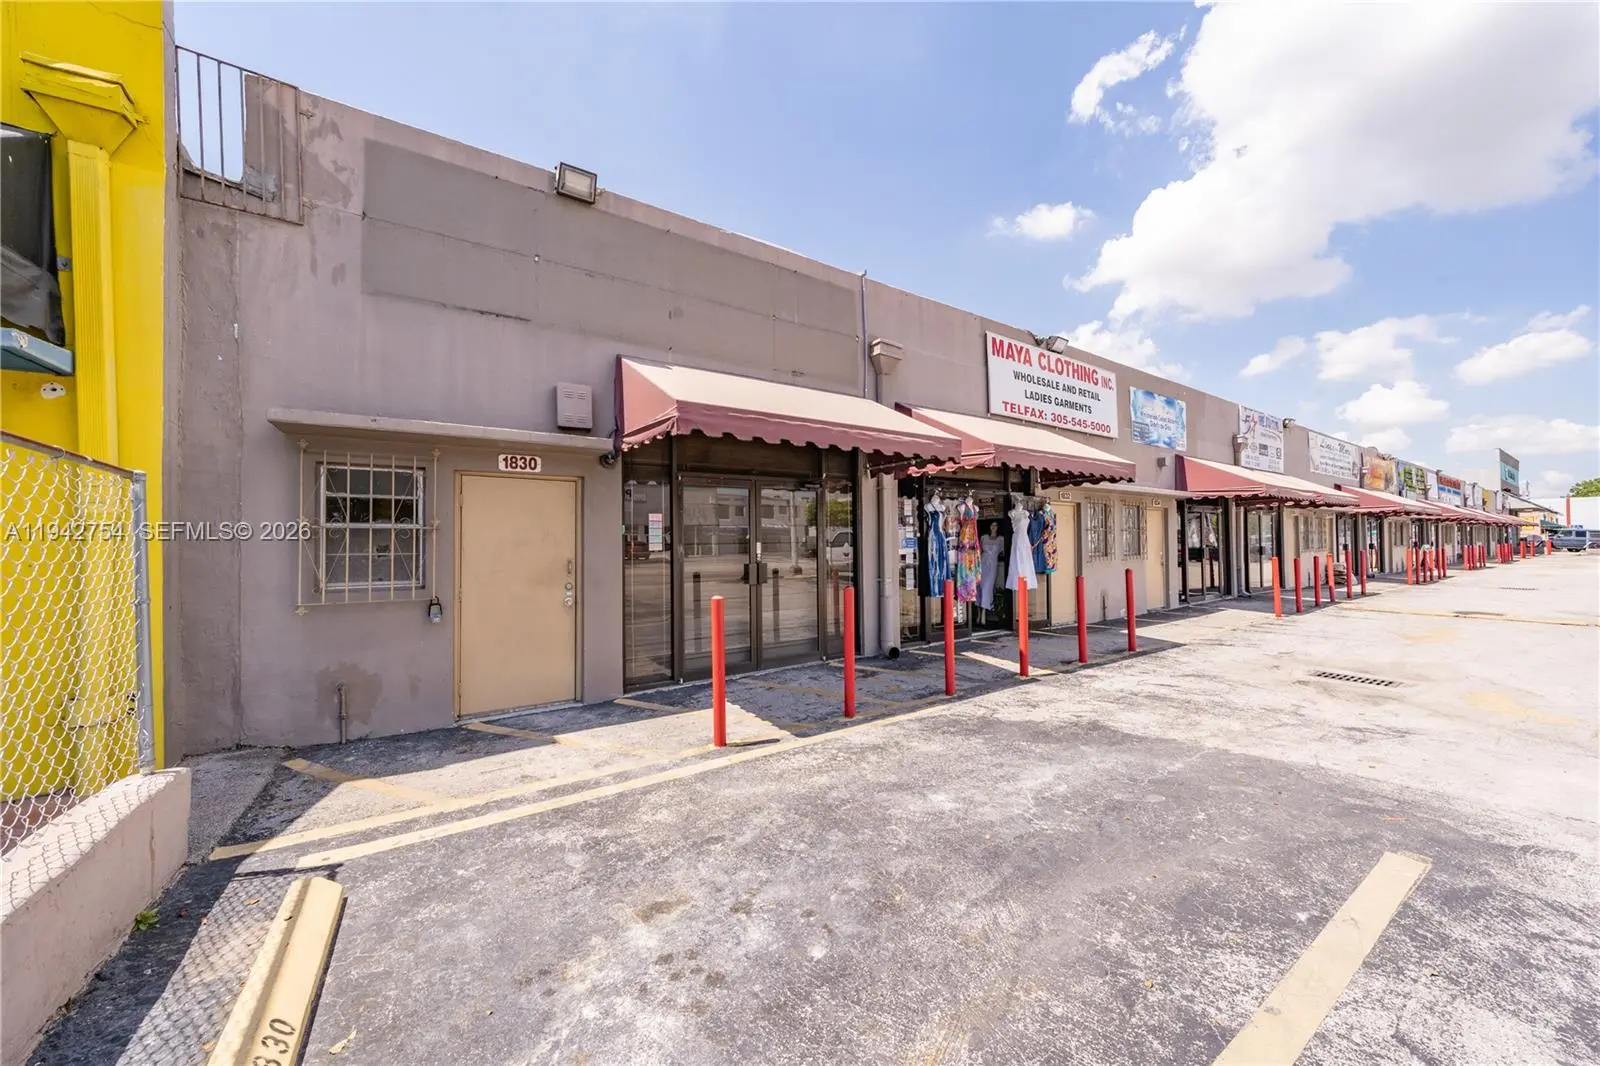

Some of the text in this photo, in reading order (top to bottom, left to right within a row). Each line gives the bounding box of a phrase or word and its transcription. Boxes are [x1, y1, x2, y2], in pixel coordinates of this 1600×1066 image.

[991, 337, 1115, 391] MAYA CLOTHING INC.
[1013, 370, 1060, 391] WHOLESALE
[1062, 383, 1077, 395] AND
[1024, 389, 1092, 414] LADIES GARMENTS
[1002, 401, 1112, 434] TELFAX: 305-545-5000
[502, 455, 538, 471] 1830
